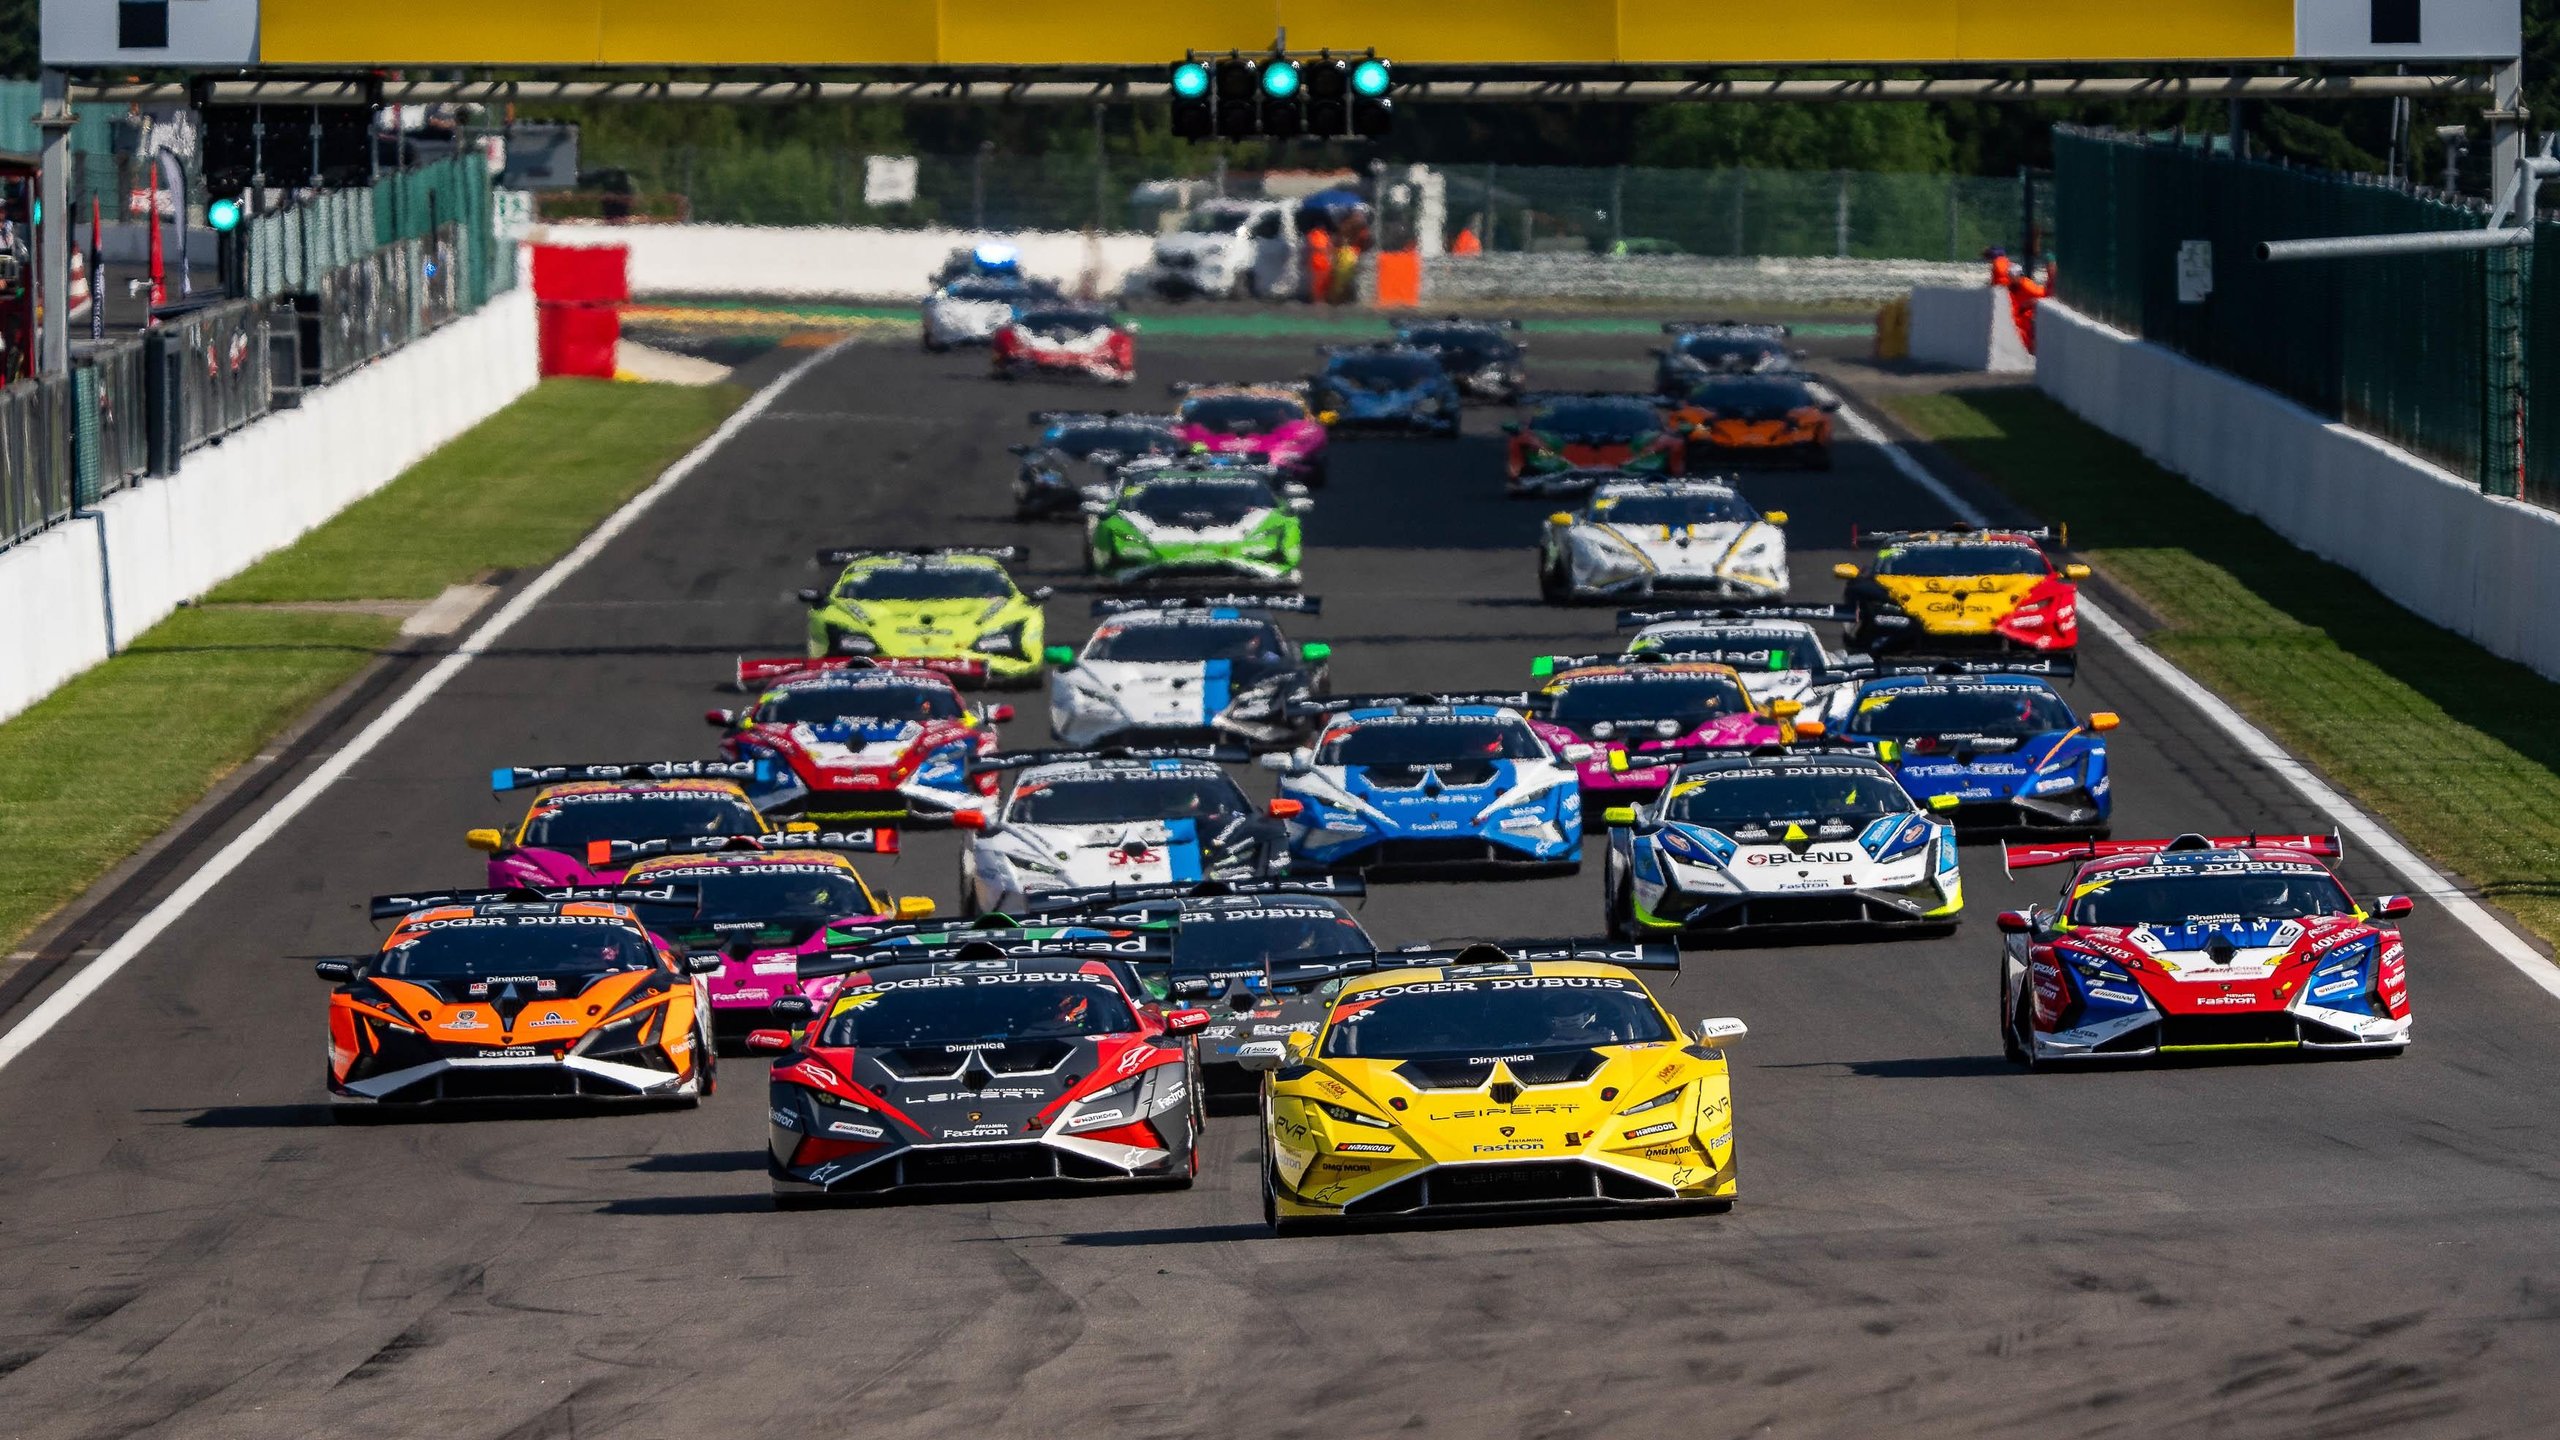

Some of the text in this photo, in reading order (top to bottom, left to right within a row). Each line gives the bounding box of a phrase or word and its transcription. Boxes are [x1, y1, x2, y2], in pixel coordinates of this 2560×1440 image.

[1686, 766, 1880, 782] ROGER DUBUIS
[1769, 851, 1854, 865] BLEND
[637, 863, 842, 881] ROGER DUBUIS
[2094, 862, 2313, 880] ROGER DUBUIS
[1225, 908, 1336, 920] DUBUIS
[408, 915, 625, 931] ROGER DUBUIS
[2164, 922, 2268, 936] LERAM
[486, 975, 539, 983] Dinamica
[851, 973, 1101, 995] ROGER DUBUIS
[1355, 978, 1624, 1001] ROGER DUBUIS
[2197, 997, 2256, 1006] Fastron
[478, 1049, 536, 1057] Fastron
[945, 1041, 1006, 1053] Dinamica
[1469, 1054, 1535, 1065] Dinamica
[1157, 1087, 1187, 1109] Fastron
[1430, 1106, 1580, 1121] LEIPERT
[1703, 1096, 1731, 1122] PVR
[943, 1128, 1009, 1138] Fastron
[1277, 1116, 1307, 1141] PVR
[1473, 1143, 1544, 1152] Fastron
[1646, 1145, 1692, 1157] DMG MORI
[1323, 1162, 1372, 1172] DMG MORI
